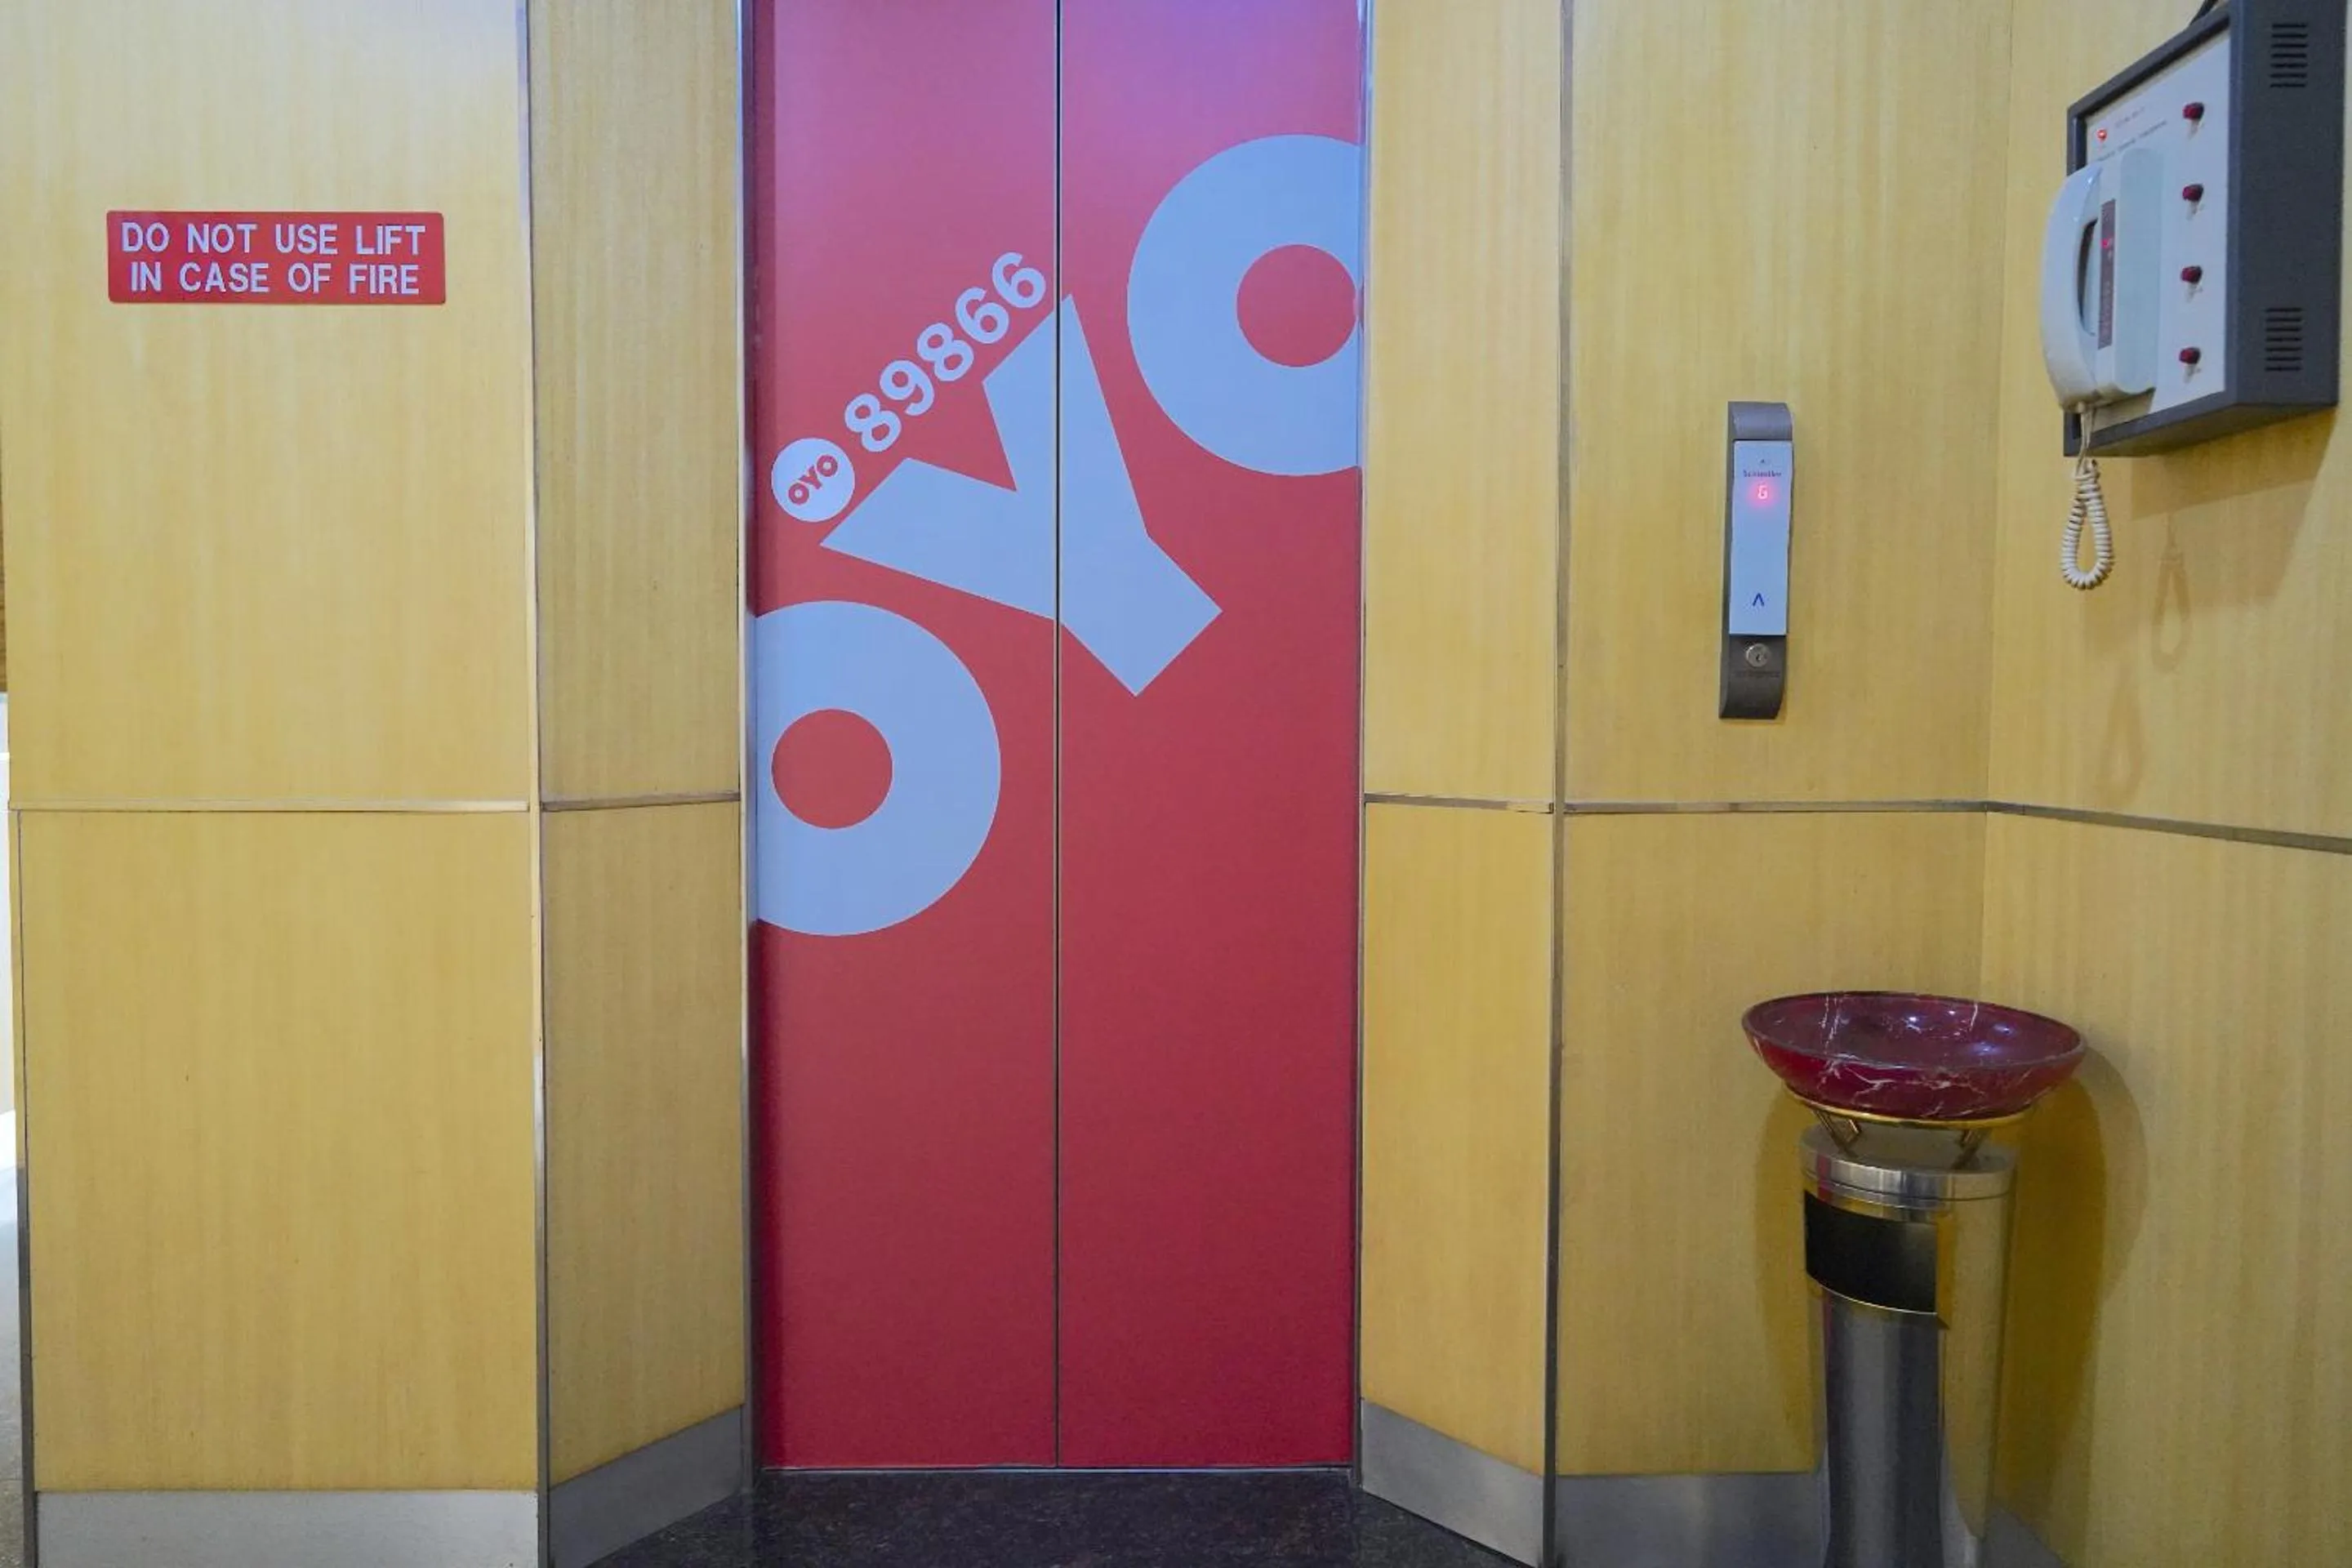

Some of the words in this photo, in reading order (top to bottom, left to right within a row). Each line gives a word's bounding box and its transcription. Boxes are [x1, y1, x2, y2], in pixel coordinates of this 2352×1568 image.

[121, 221, 170, 252] DO
[187, 223, 258, 254] NOT
[274, 224, 338, 255] USE
[356, 225, 426, 256] LIFT
[130, 261, 162, 292] IN
[179, 261, 270, 292] CASE
[287, 262, 332, 293] OF
[349, 263, 420, 295] FIRE
[788, 454, 838, 505] OYO
[844, 252, 1046, 452] 89866
[755, 134, 1362, 937] OYO
